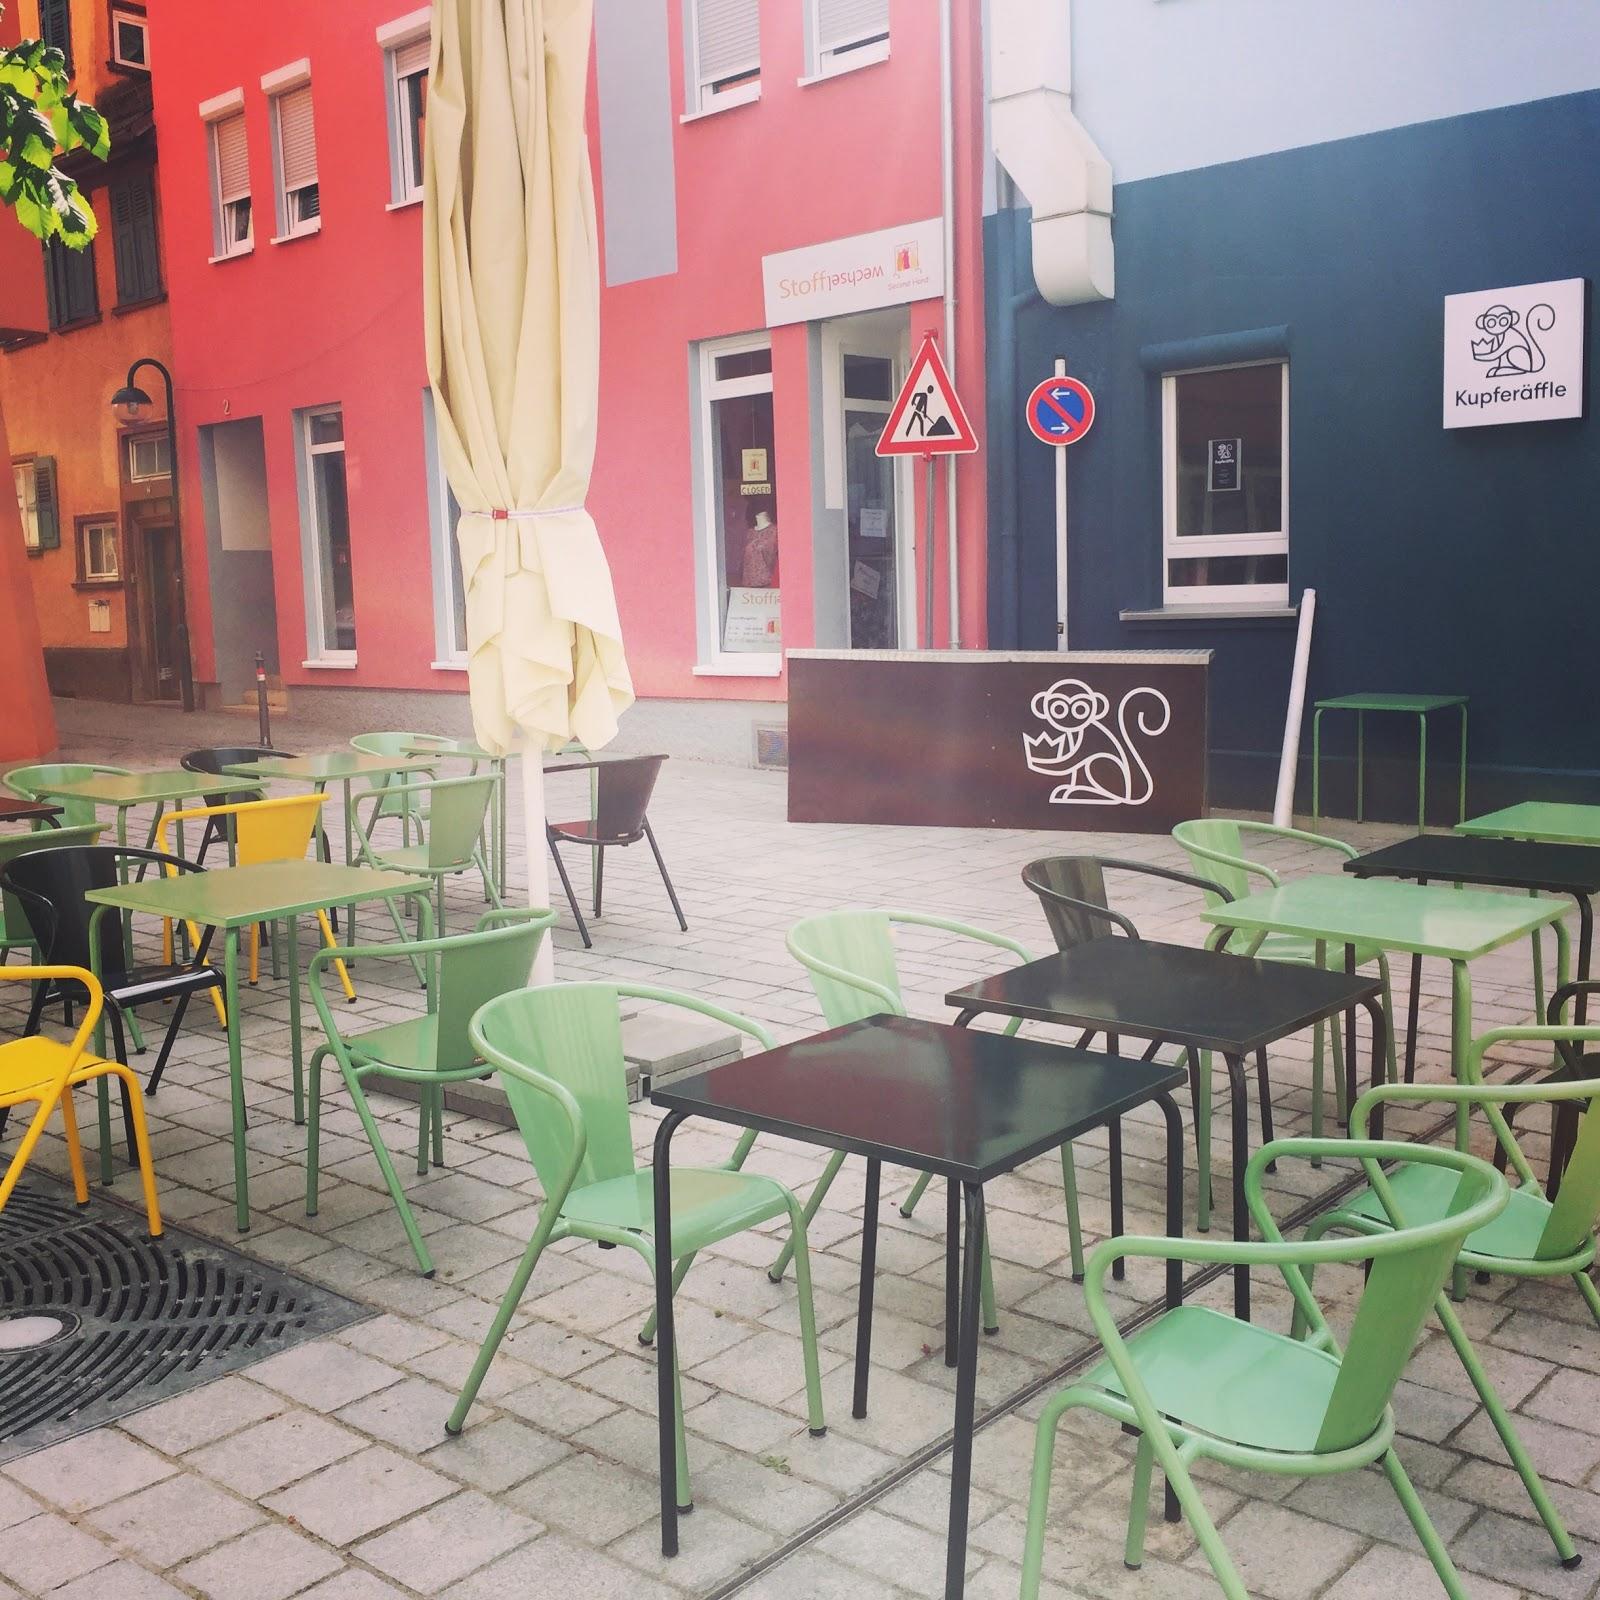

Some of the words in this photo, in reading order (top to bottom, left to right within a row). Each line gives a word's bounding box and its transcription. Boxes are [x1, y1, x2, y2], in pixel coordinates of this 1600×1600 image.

[1455, 381, 1567, 408] Kupferäffle
[222, 399, 231, 416] 2
[741, 486, 770, 495] CLOSED
